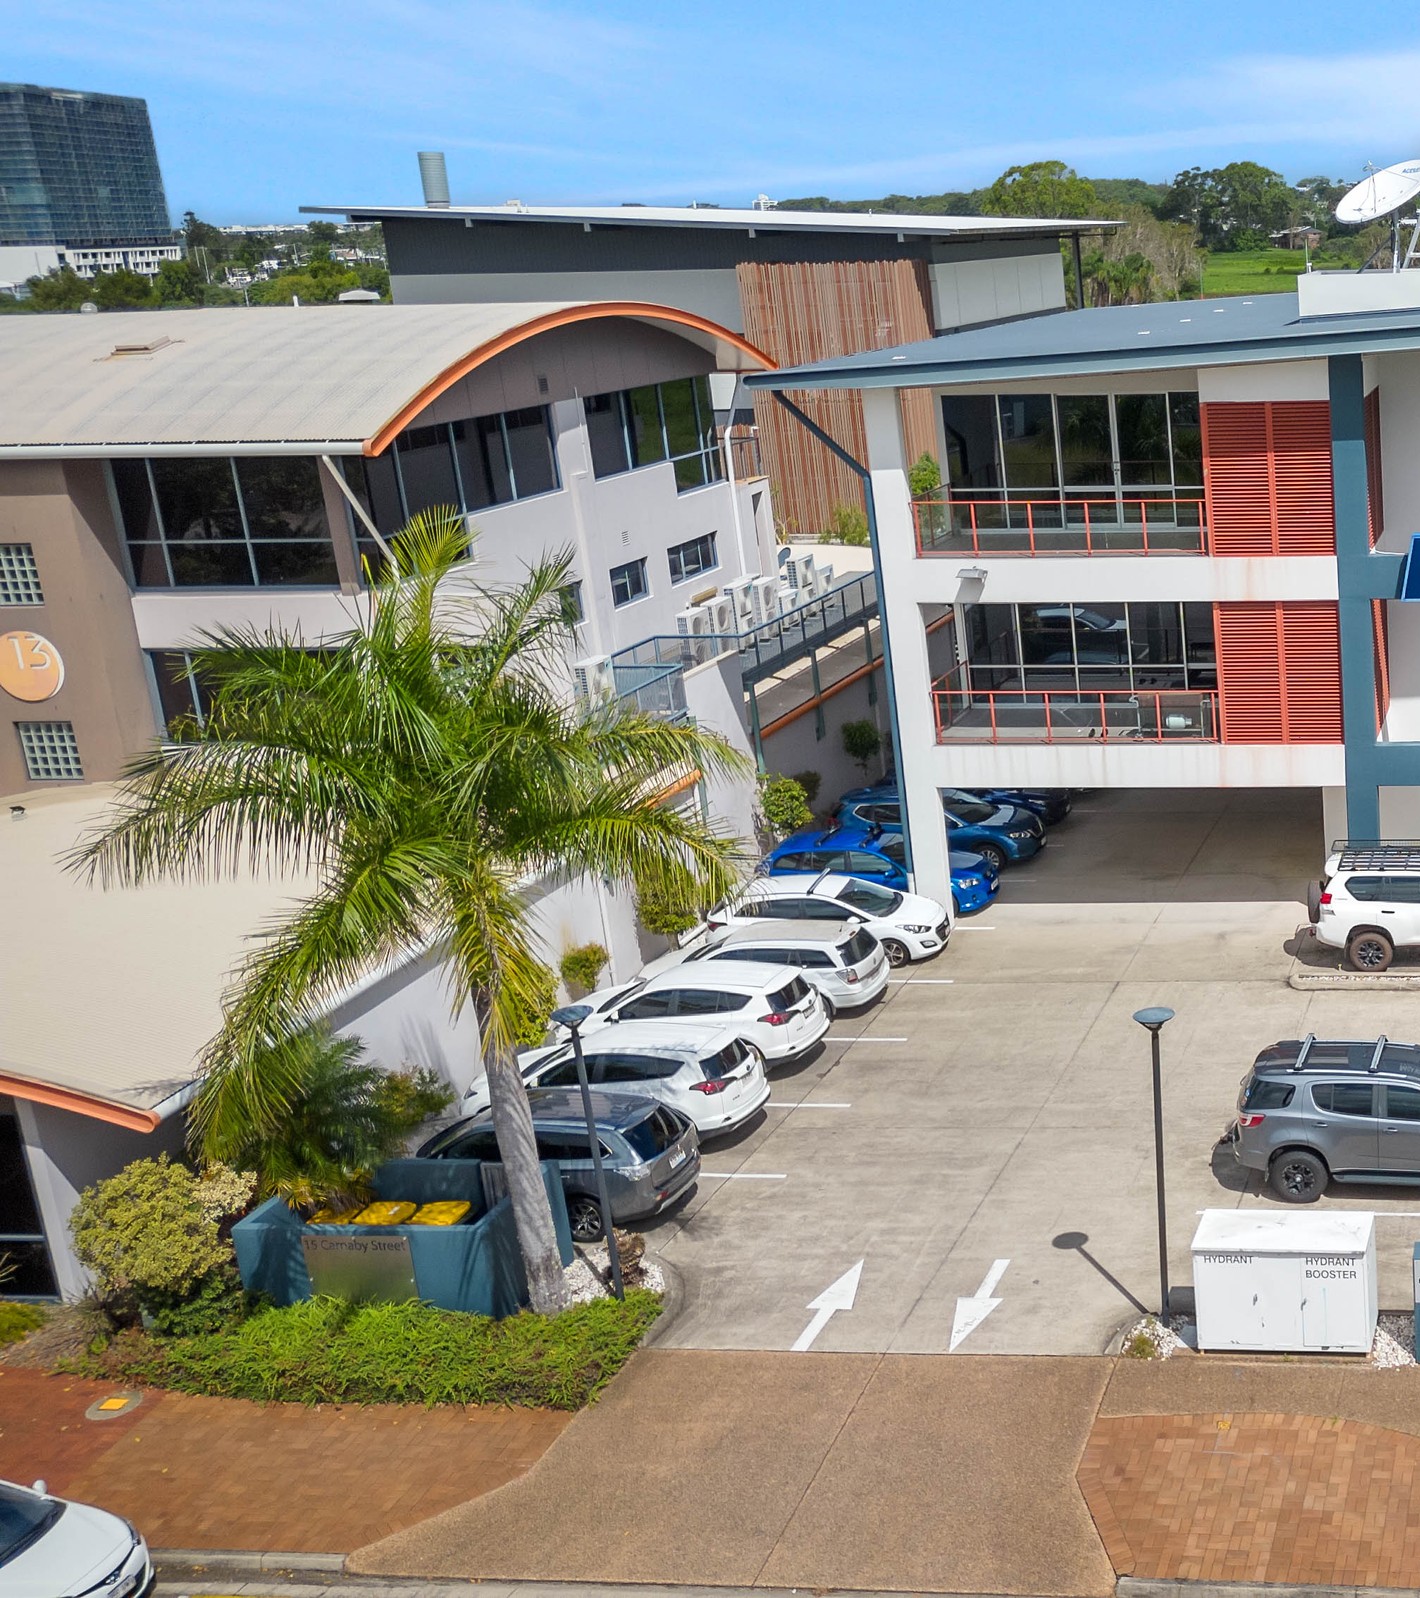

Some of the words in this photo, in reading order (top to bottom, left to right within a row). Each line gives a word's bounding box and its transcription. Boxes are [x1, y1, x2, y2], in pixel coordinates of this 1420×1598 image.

[7, 635, 51, 670] 13
[305, 1240, 318, 1250] 15
[321, 1239, 368, 1253] Carnaby
[371, 1240, 405, 1251] Street
[1203, 1255, 1254, 1264] HYDRANT
[1305, 1257, 1356, 1267] HYDRANT
[1305, 1270, 1357, 1279] BOOSTER
